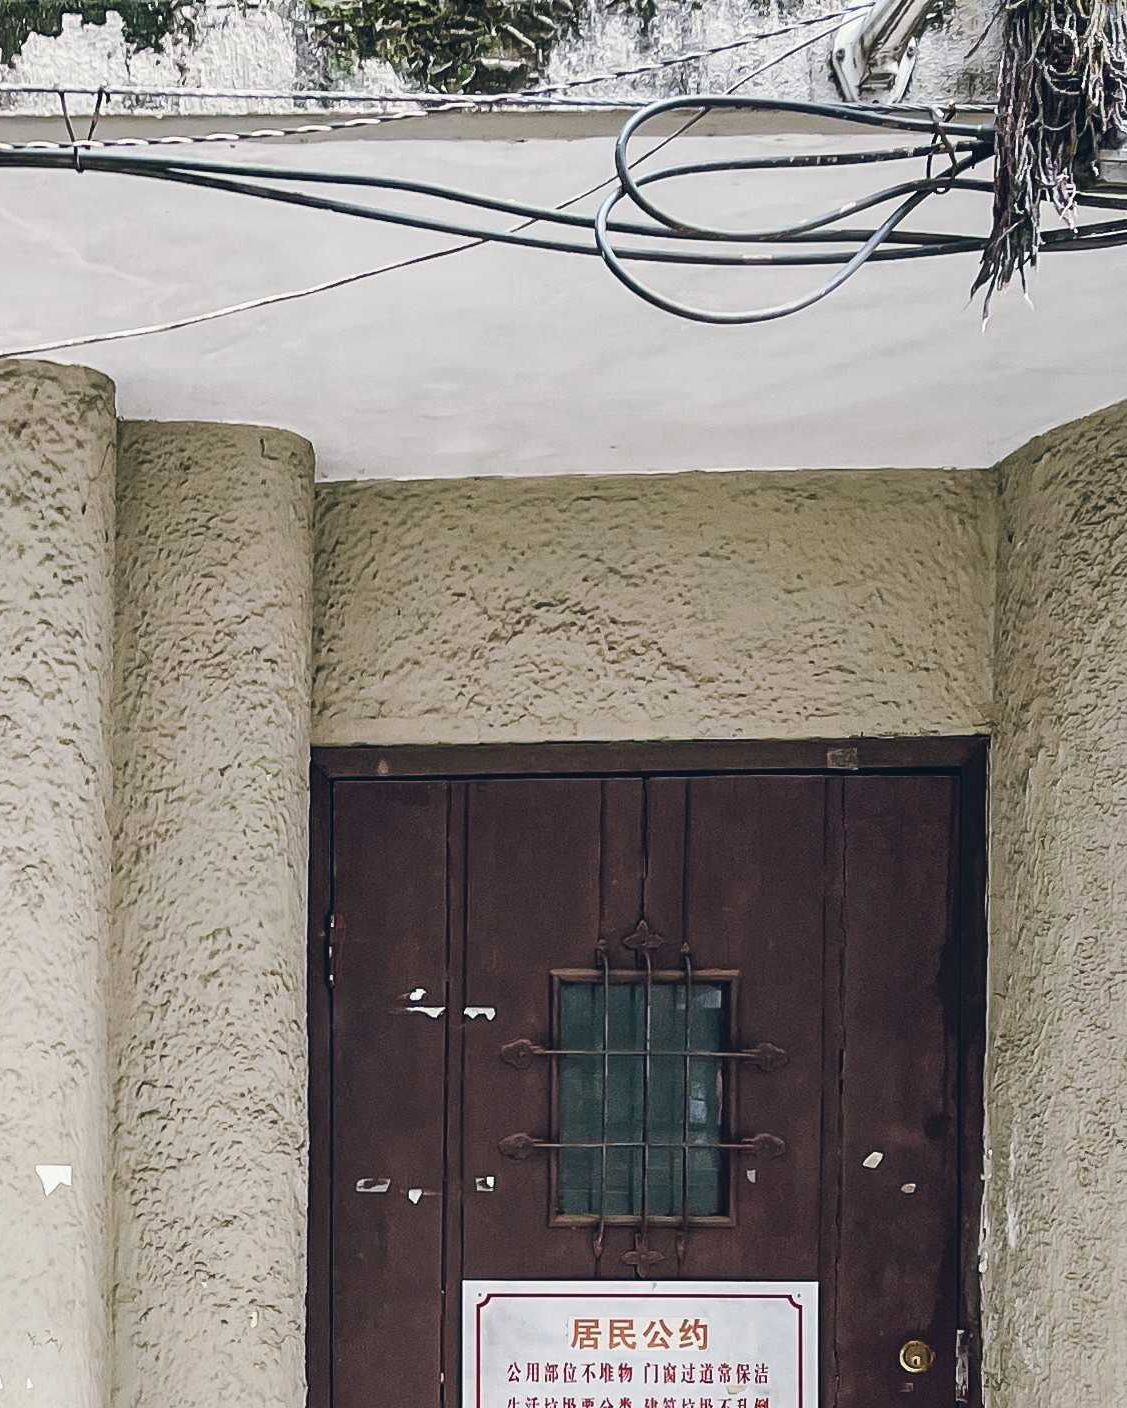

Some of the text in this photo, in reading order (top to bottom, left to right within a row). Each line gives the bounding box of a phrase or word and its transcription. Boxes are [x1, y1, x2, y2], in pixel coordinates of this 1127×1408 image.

[570, 1318, 709, 1351] 居民公约
[506, 1361, 769, 1385] 公用部位不堆物 门窗过道常保洁
